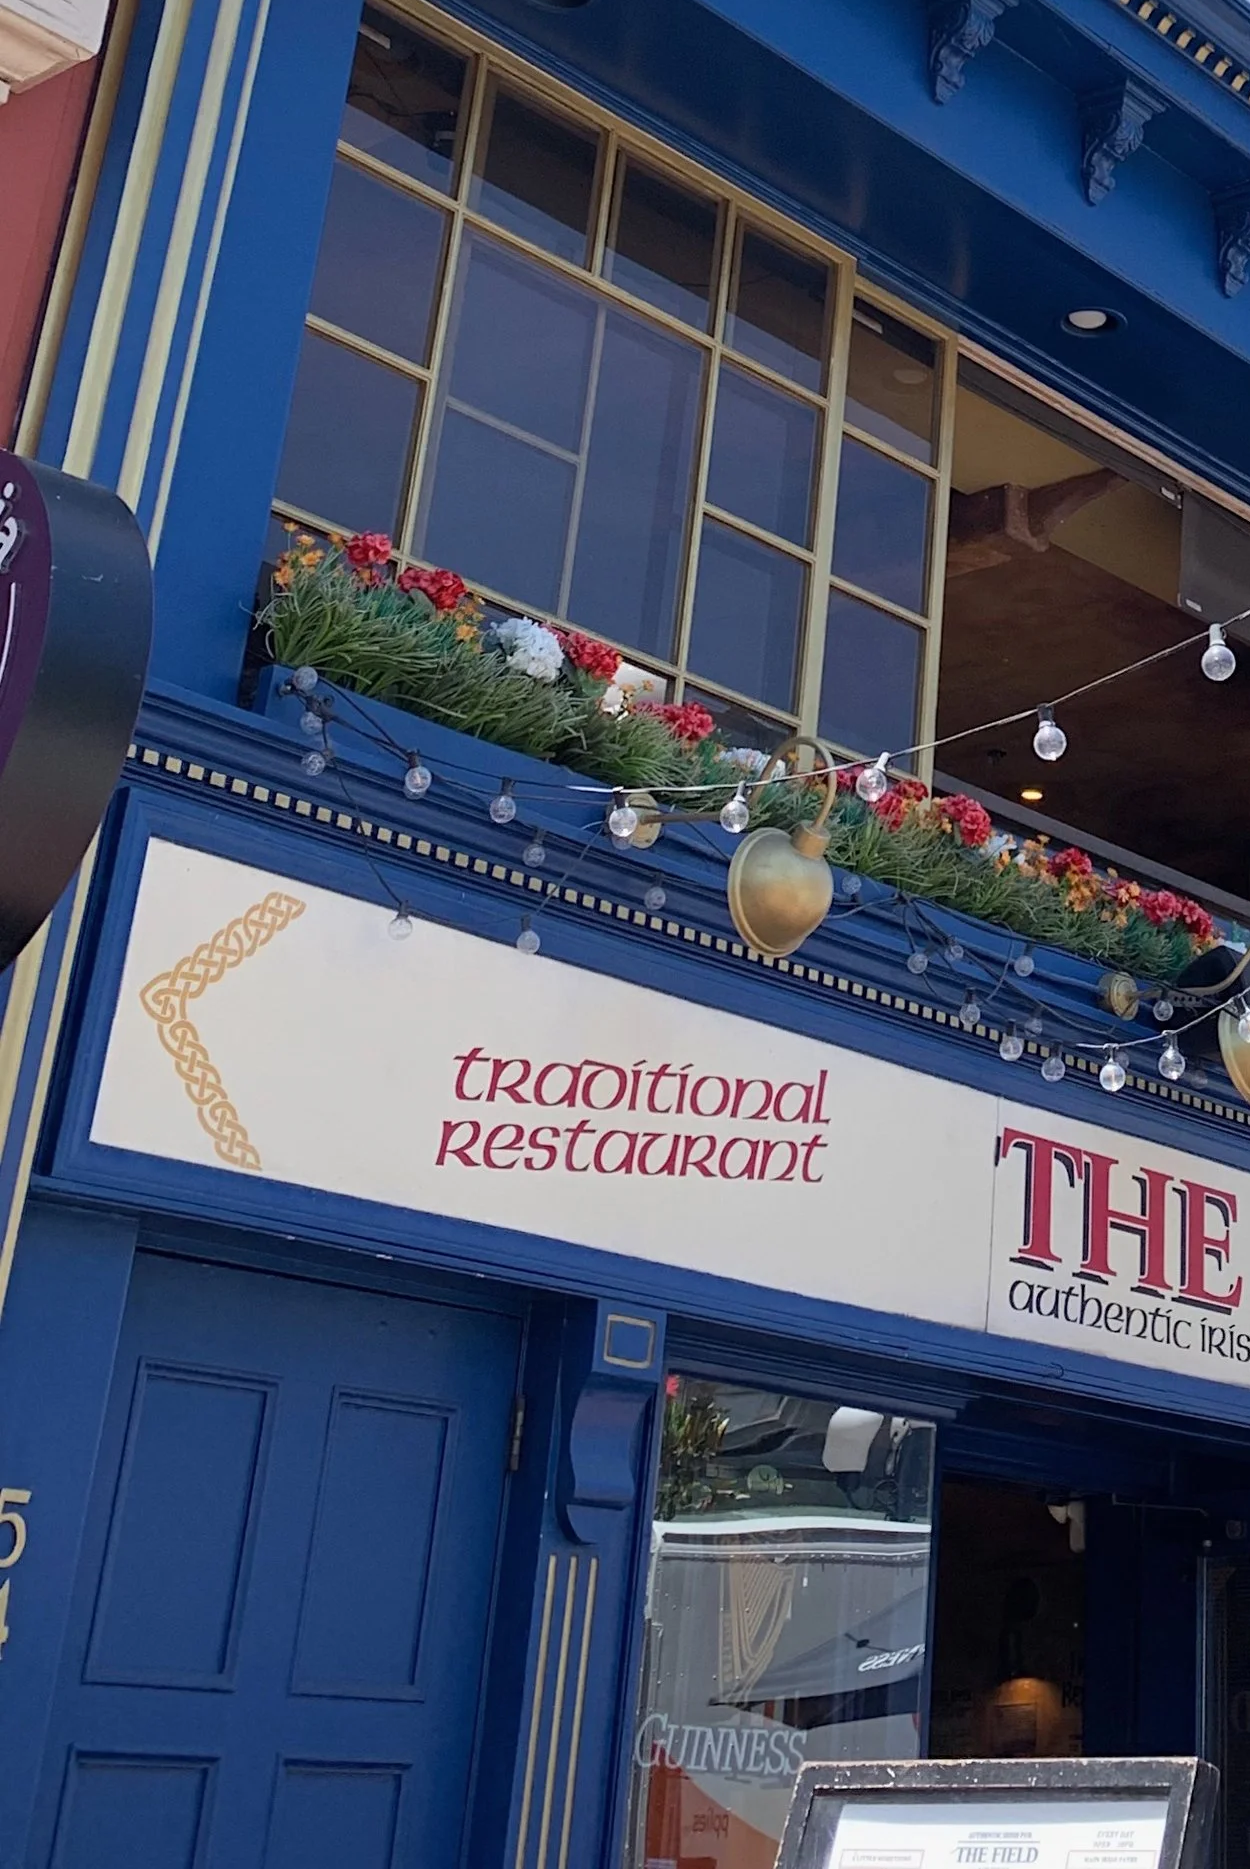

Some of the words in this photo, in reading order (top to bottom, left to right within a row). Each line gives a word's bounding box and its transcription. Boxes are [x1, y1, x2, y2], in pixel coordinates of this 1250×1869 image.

[451, 1046, 831, 1125] traditional
[434, 1119, 828, 1184] restaurant
[995, 1126, 1244, 1316] THE
[1007, 1276, 1193, 1349] authentic
[633, 1712, 808, 1775] GUINNESS
[956, 1846, 989, 1863] THE
[991, 1846, 1039, 1863] FIELD
